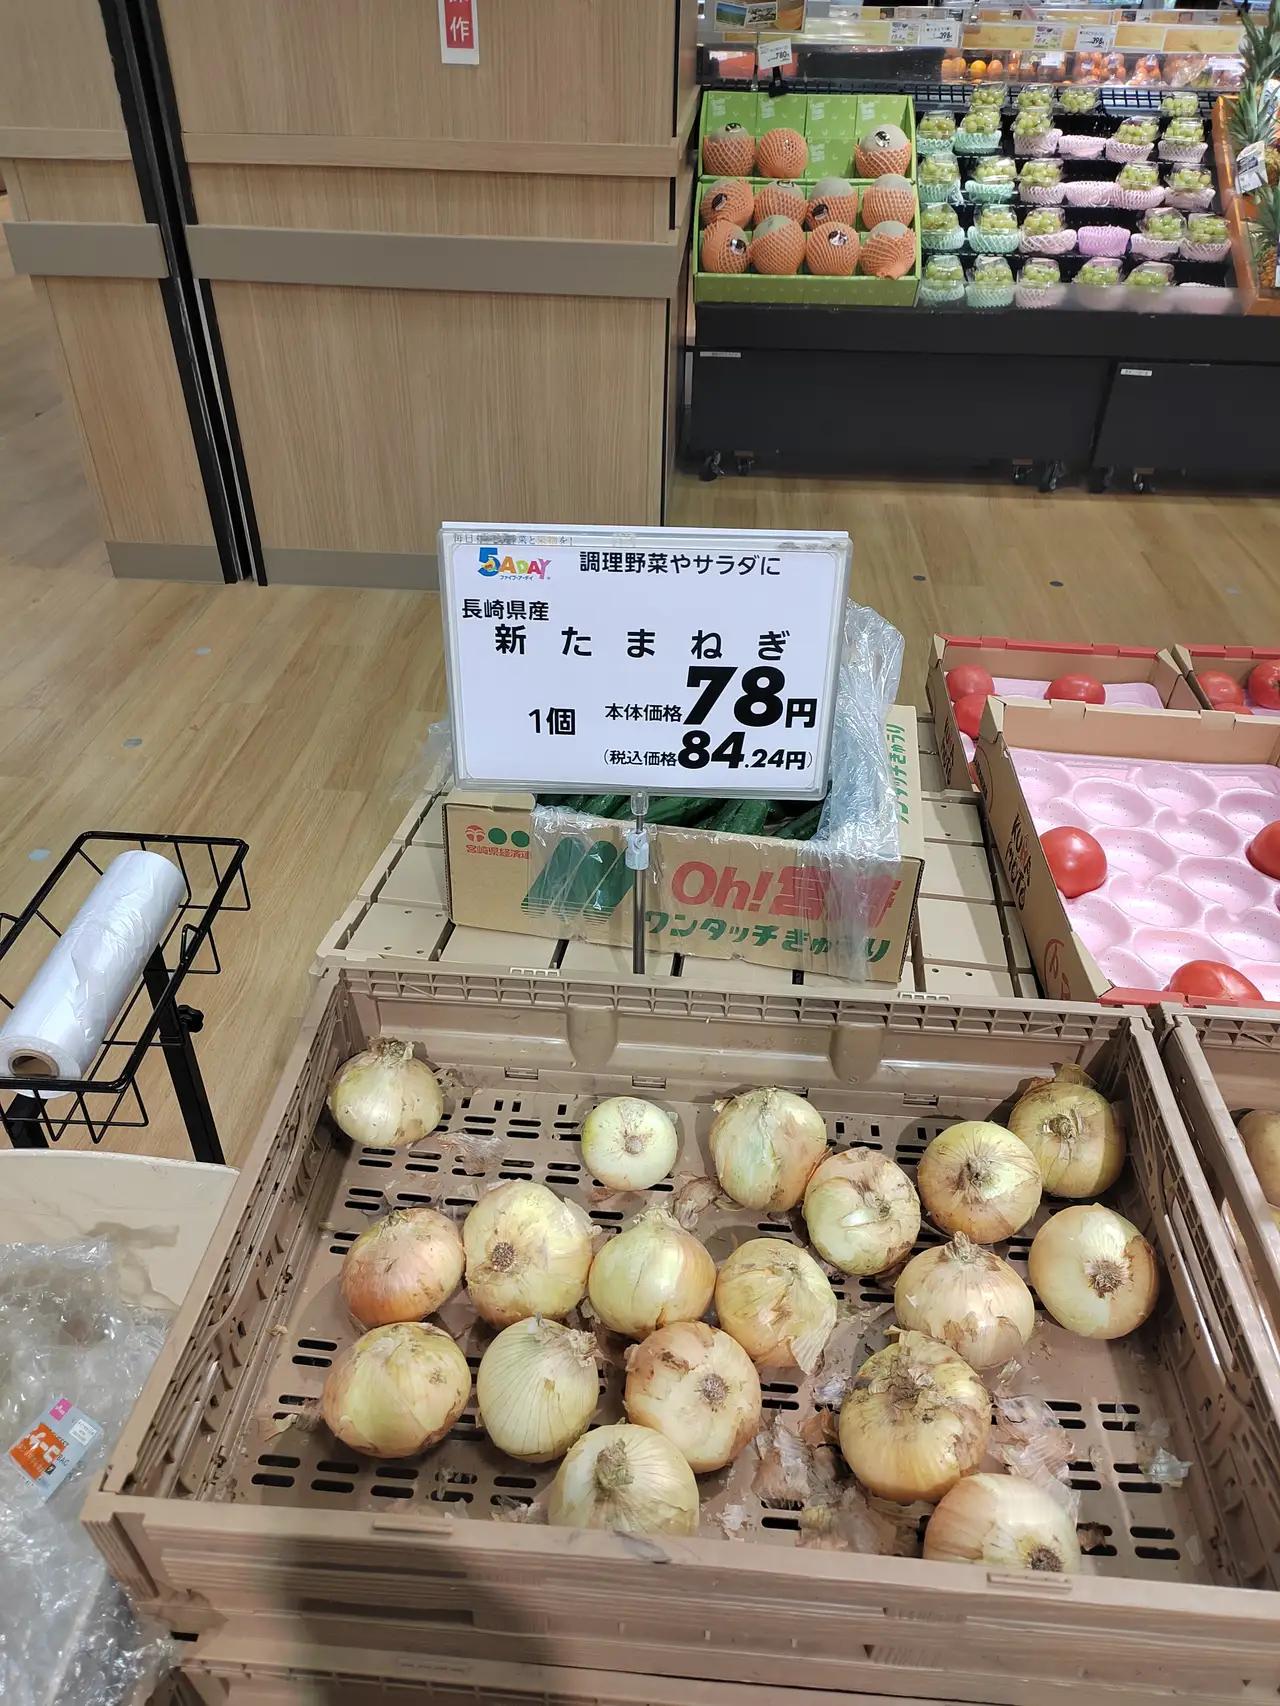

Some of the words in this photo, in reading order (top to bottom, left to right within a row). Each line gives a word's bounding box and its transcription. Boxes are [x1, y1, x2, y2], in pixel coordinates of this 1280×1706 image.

[579, 550, 781, 576] 調理野菜やサラダに
[461, 598, 549, 621] 長崎県産
[528, 706, 576, 735] 1個
[645, 910, 891, 963] ワンタッチきゅり
